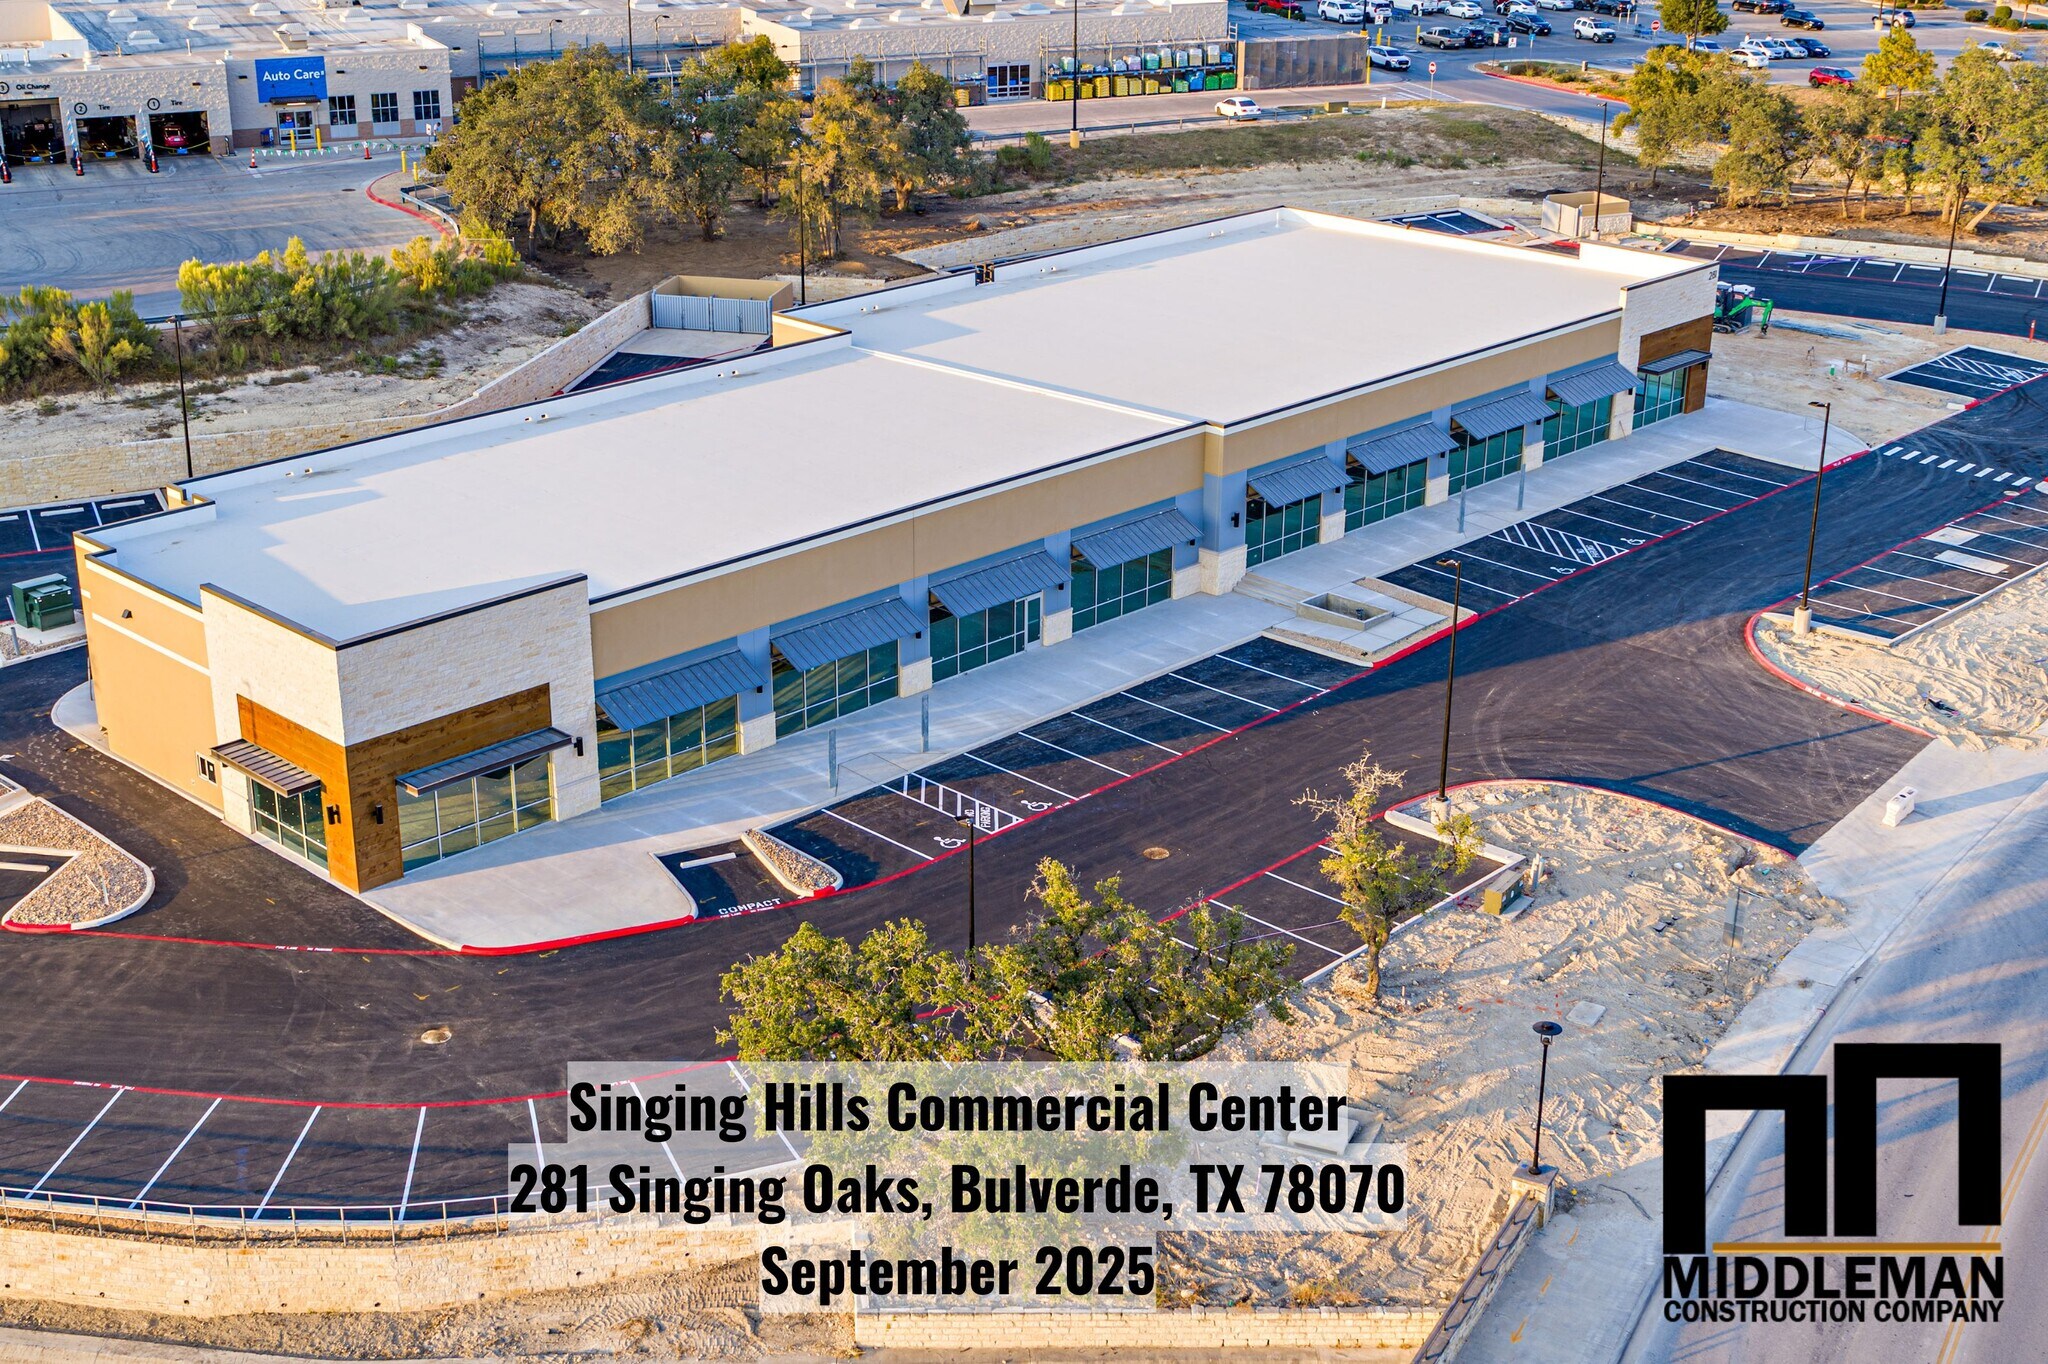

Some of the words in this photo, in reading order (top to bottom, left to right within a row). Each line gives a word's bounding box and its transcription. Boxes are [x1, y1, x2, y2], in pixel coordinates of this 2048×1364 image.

[263, 71, 291, 81] Auto
[294, 69, 320, 79] Care
[718, 898, 781, 915] COMPACT
